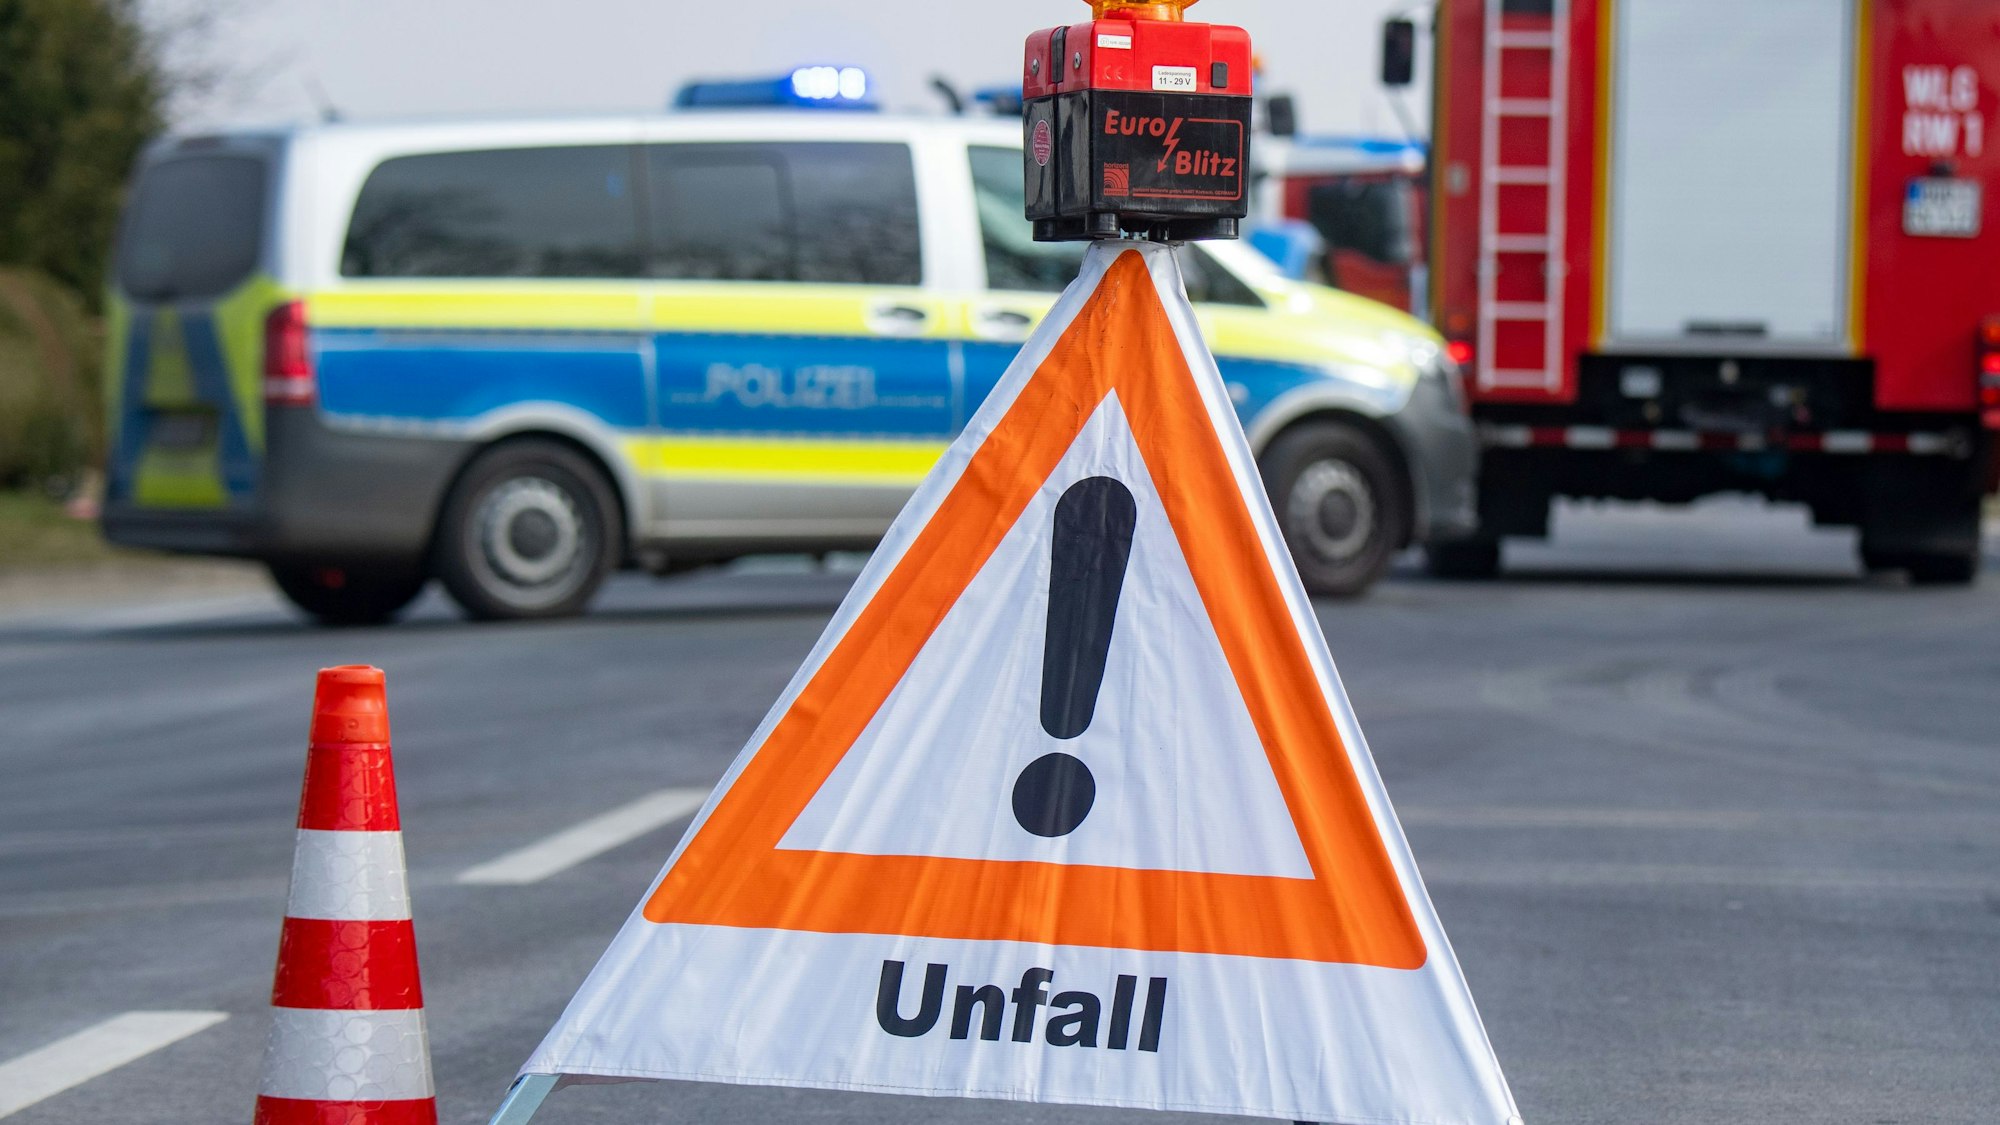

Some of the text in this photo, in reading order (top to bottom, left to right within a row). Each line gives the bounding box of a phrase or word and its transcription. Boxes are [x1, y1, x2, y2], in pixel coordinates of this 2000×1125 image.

[1158, 77, 1167, 85] 11
[1174, 78, 1183, 86] 29
[1185, 78, 1191, 86] V
[1104, 109, 1166, 137] Euro
[1174, 150, 1236, 177] Blitz
[705, 362, 876, 409] POLIZEI
[876, 959, 1168, 1053] Unfall
